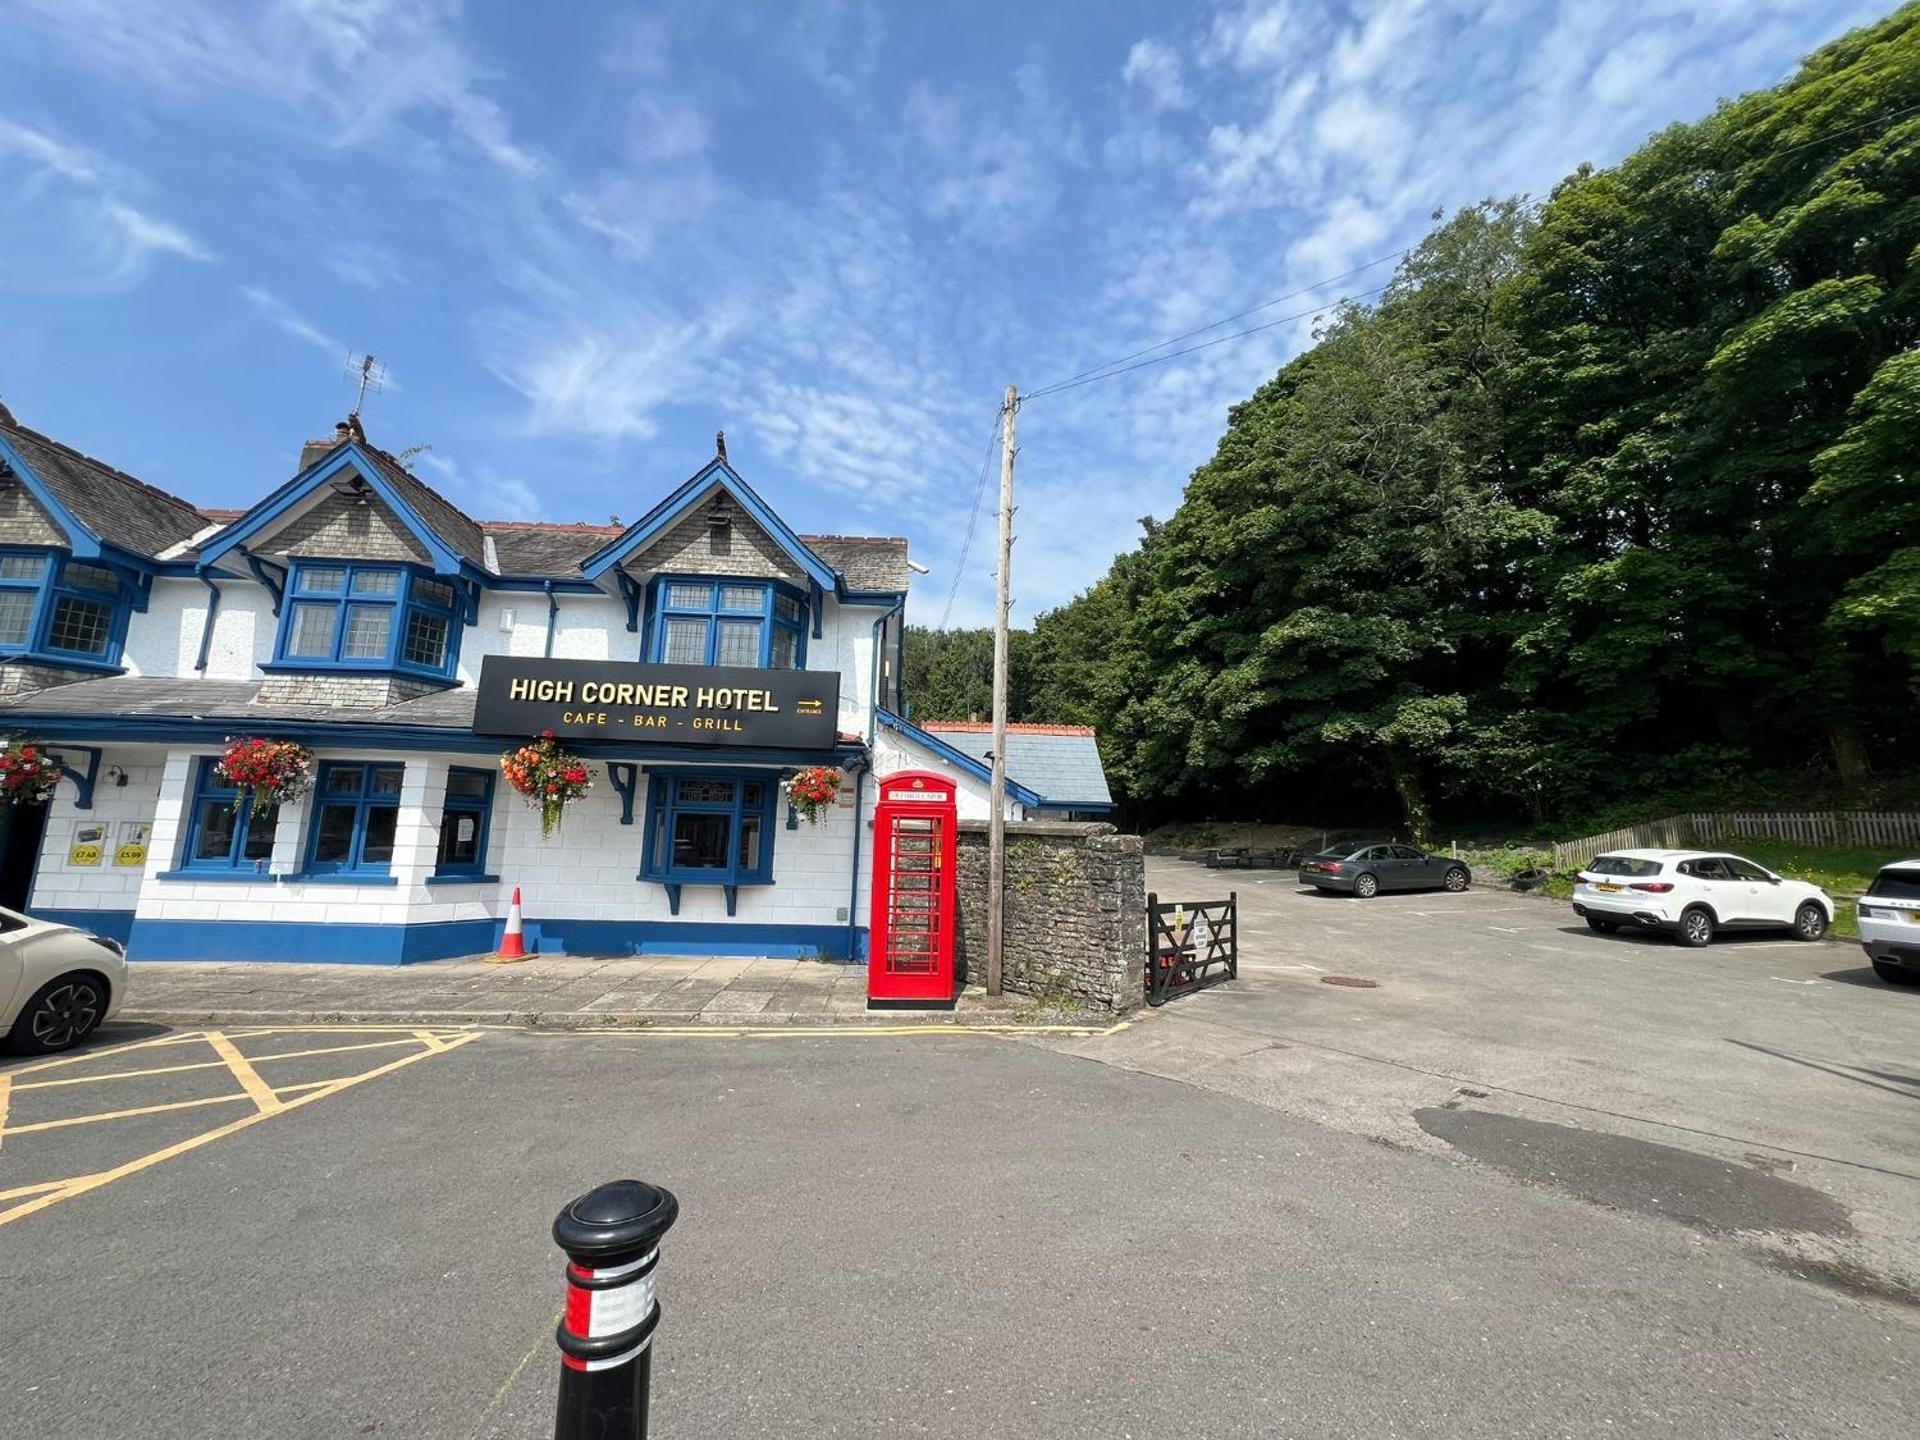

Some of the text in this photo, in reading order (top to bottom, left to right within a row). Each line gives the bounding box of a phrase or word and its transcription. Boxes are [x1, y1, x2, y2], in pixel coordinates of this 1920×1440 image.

[510, 678, 779, 711] HIGH CORNER HOTEL
[563, 711, 607, 724] CAFE
[634, 714, 667, 727] BAR
[693, 718, 743, 731] GRILL
